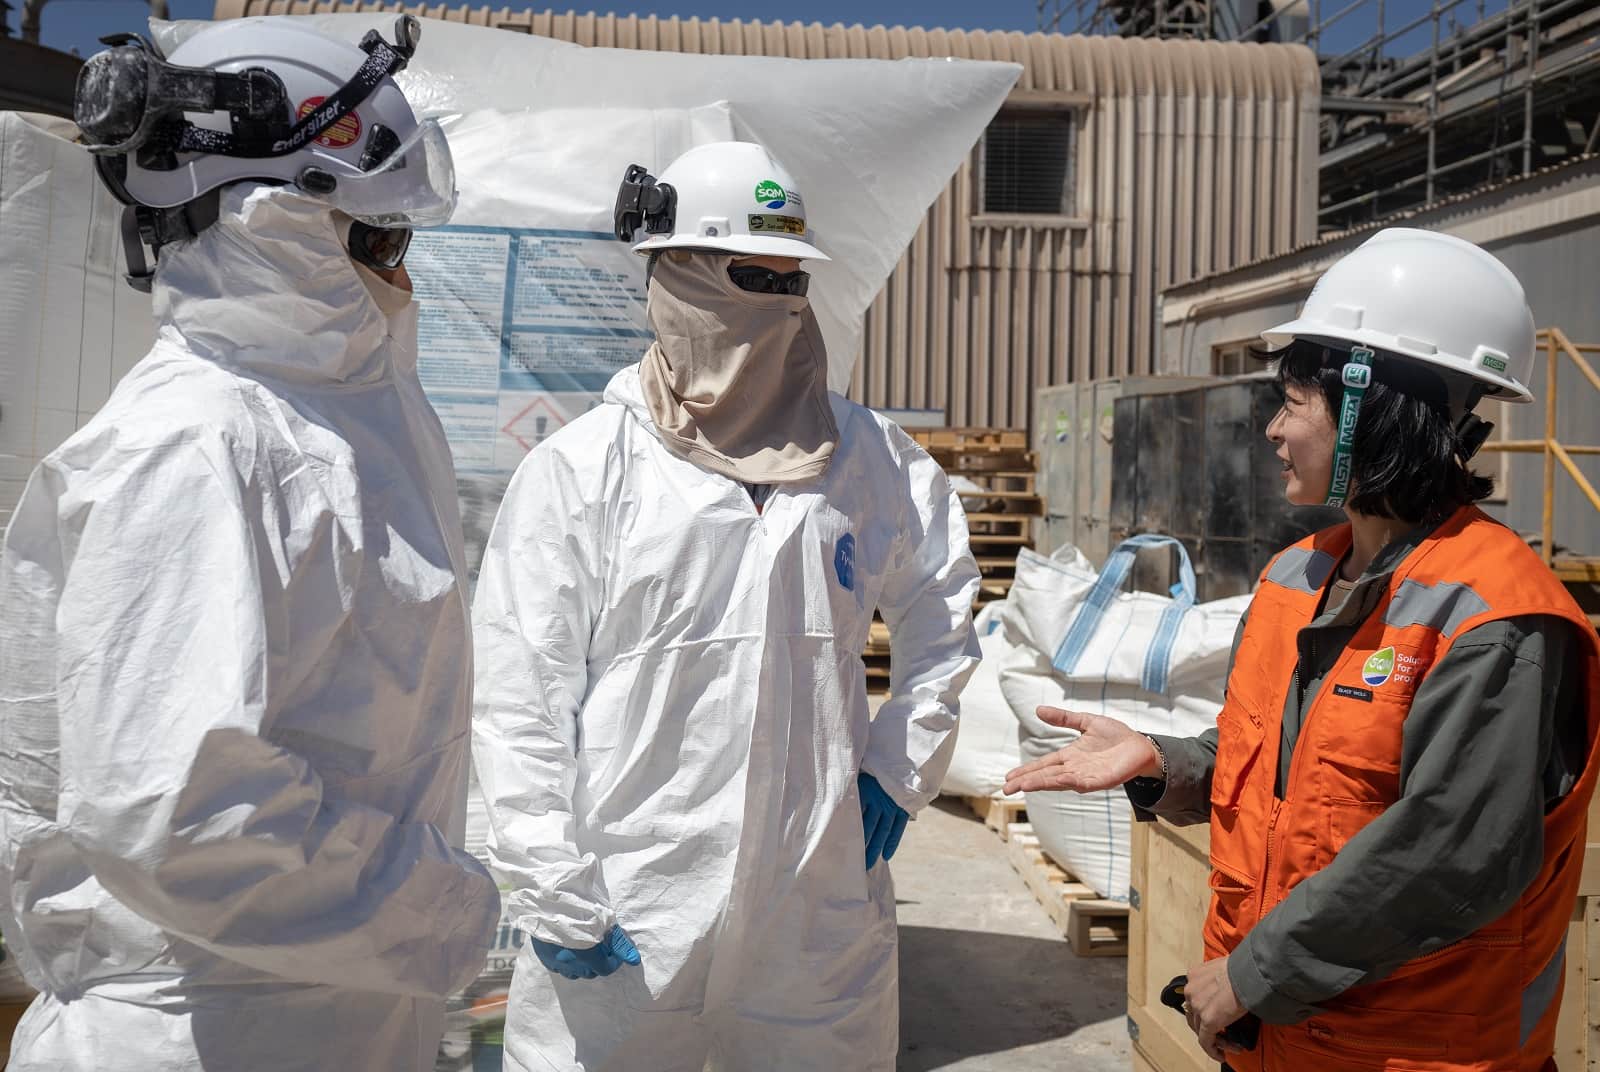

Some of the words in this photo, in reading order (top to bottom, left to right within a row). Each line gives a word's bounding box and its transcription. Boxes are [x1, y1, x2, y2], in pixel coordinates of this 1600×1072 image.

[272, 100, 340, 152] Energizer
[758, 188, 784, 198] SQM
[1484, 358, 1505, 370] MSA
[1341, 397, 1359, 445] MSA
[1333, 455, 1350, 493] MSA
